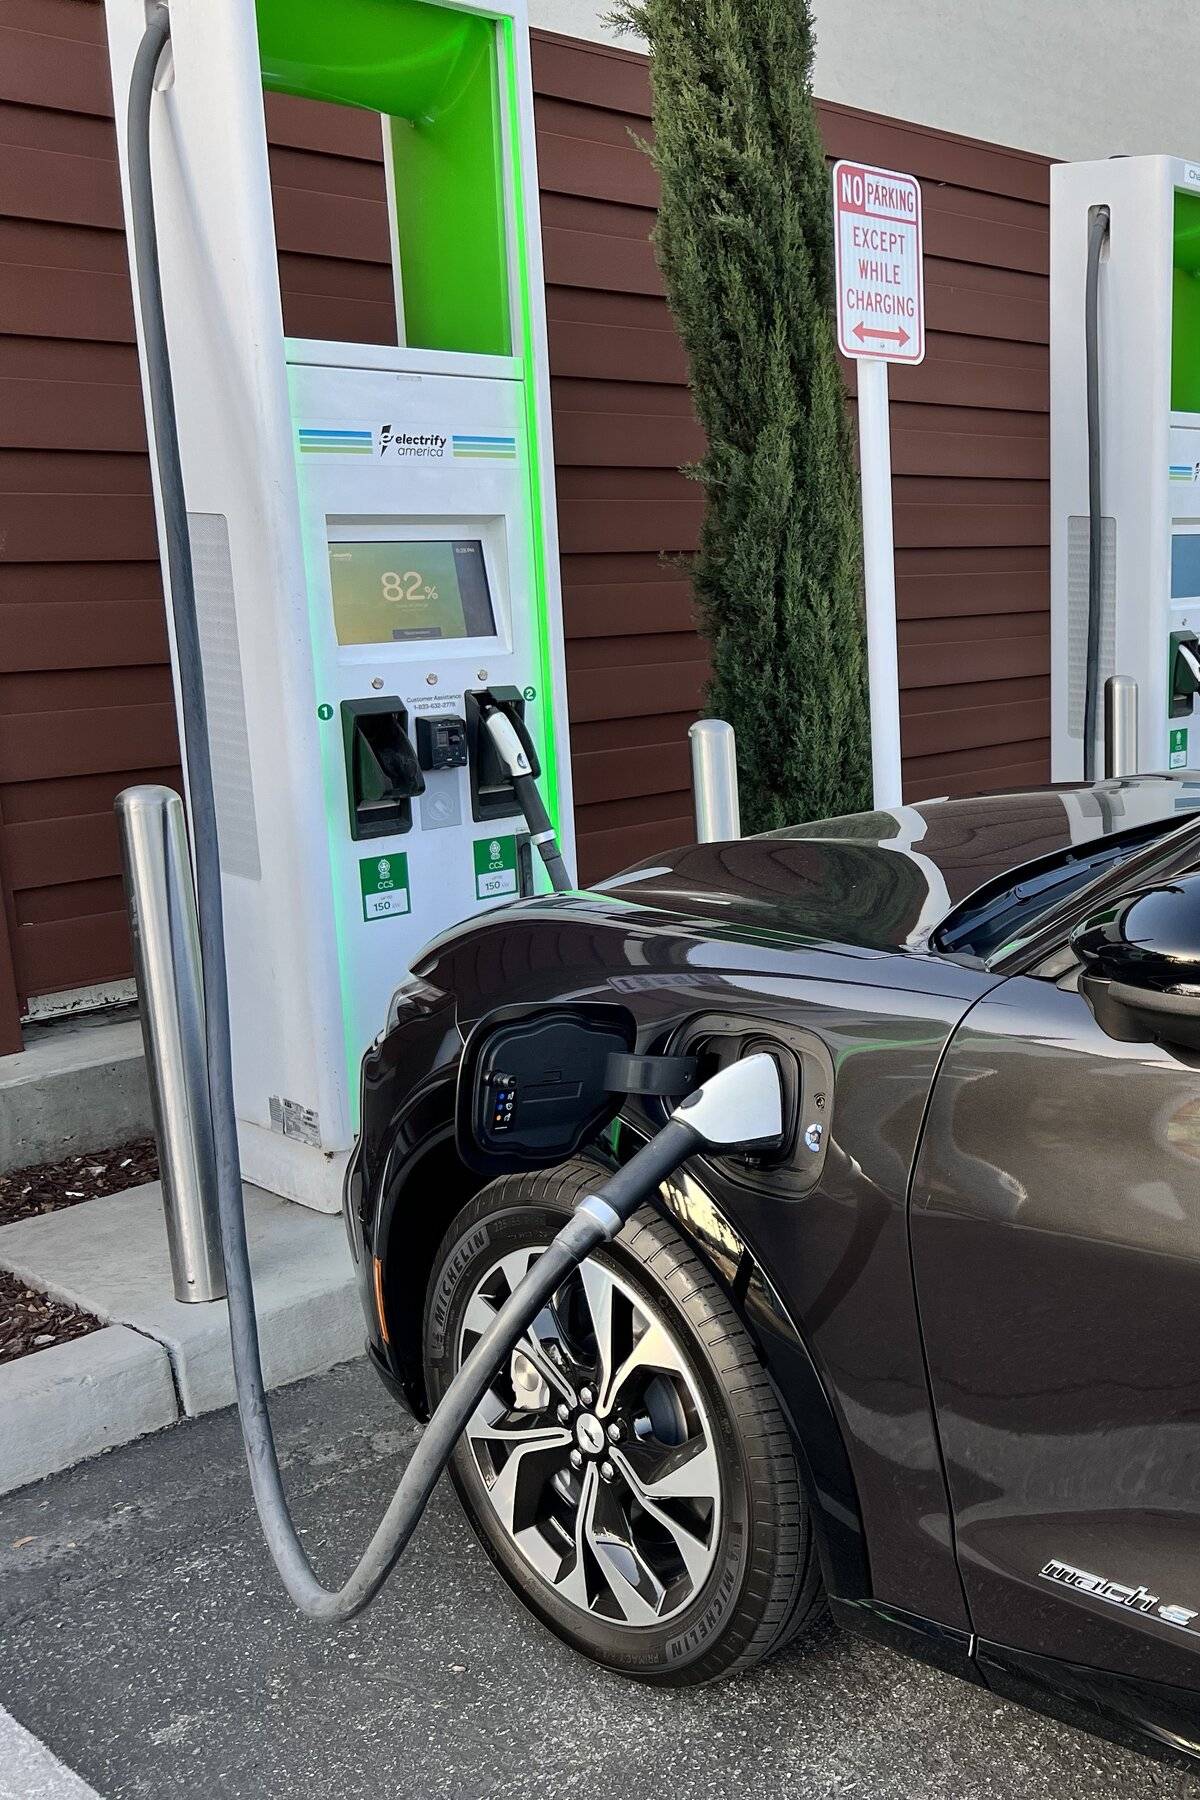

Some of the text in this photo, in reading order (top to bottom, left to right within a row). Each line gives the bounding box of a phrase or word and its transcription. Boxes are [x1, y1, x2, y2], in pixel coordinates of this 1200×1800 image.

[841, 172, 914, 213] NO PARKING
[853, 226, 905, 255] EXCEPT
[858, 258, 901, 285] WHILE
[846, 288, 915, 318] CHARGING
[395, 434, 446, 448] electrify
[397, 446, 444, 457] america
[433, 693, 462, 702] Assistance
[488, 861, 504, 870] CCS
[377, 880, 394, 890] CCS
[485, 881, 501, 891] 150
[373, 901, 391, 912] 150
[435, 1230, 485, 1327] MICHELIN
[670, 1568, 735, 1658] MICHELIN
